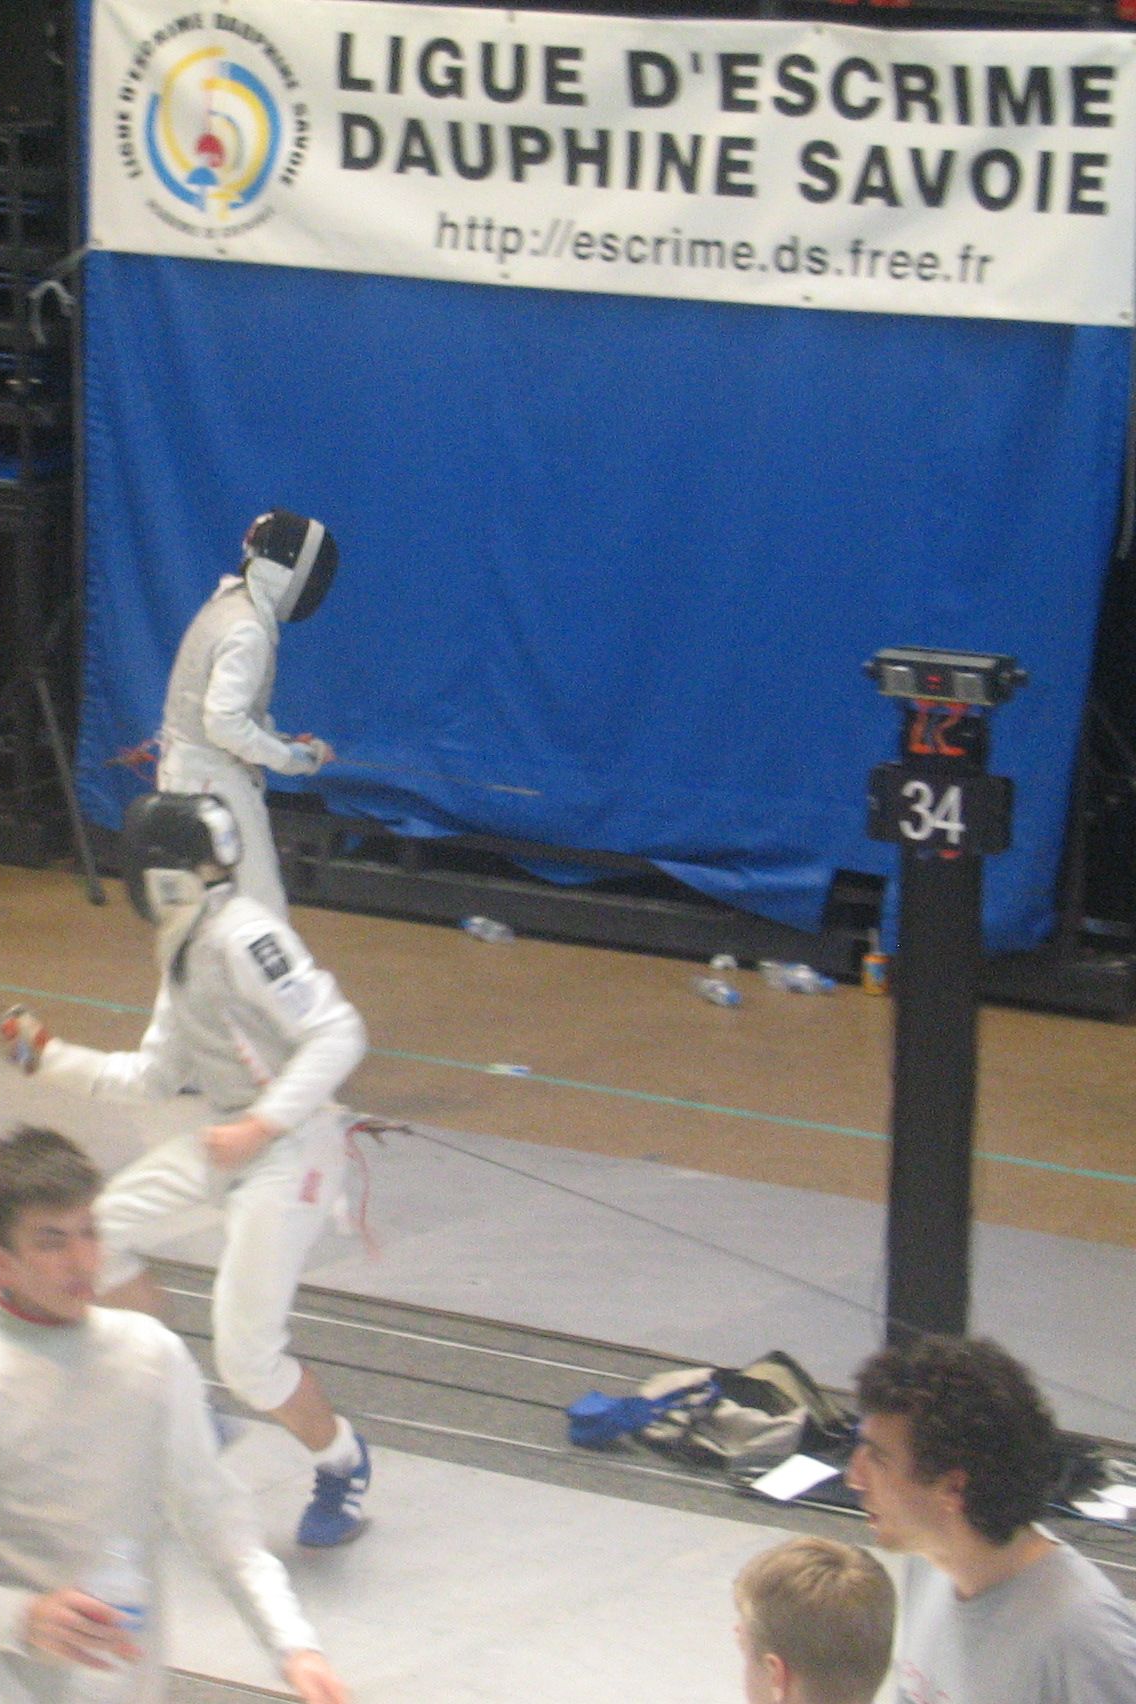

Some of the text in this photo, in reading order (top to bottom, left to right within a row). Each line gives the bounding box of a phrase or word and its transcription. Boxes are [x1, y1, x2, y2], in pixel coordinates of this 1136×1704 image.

[337, 31, 1116, 128] LIGUE D'ESCRIME
[339, 111, 1110, 215] DAUPHINE SAVOIE
[433, 211, 995, 284] http://escrime.ds.free.fr
[898, 780, 966, 844] 34
